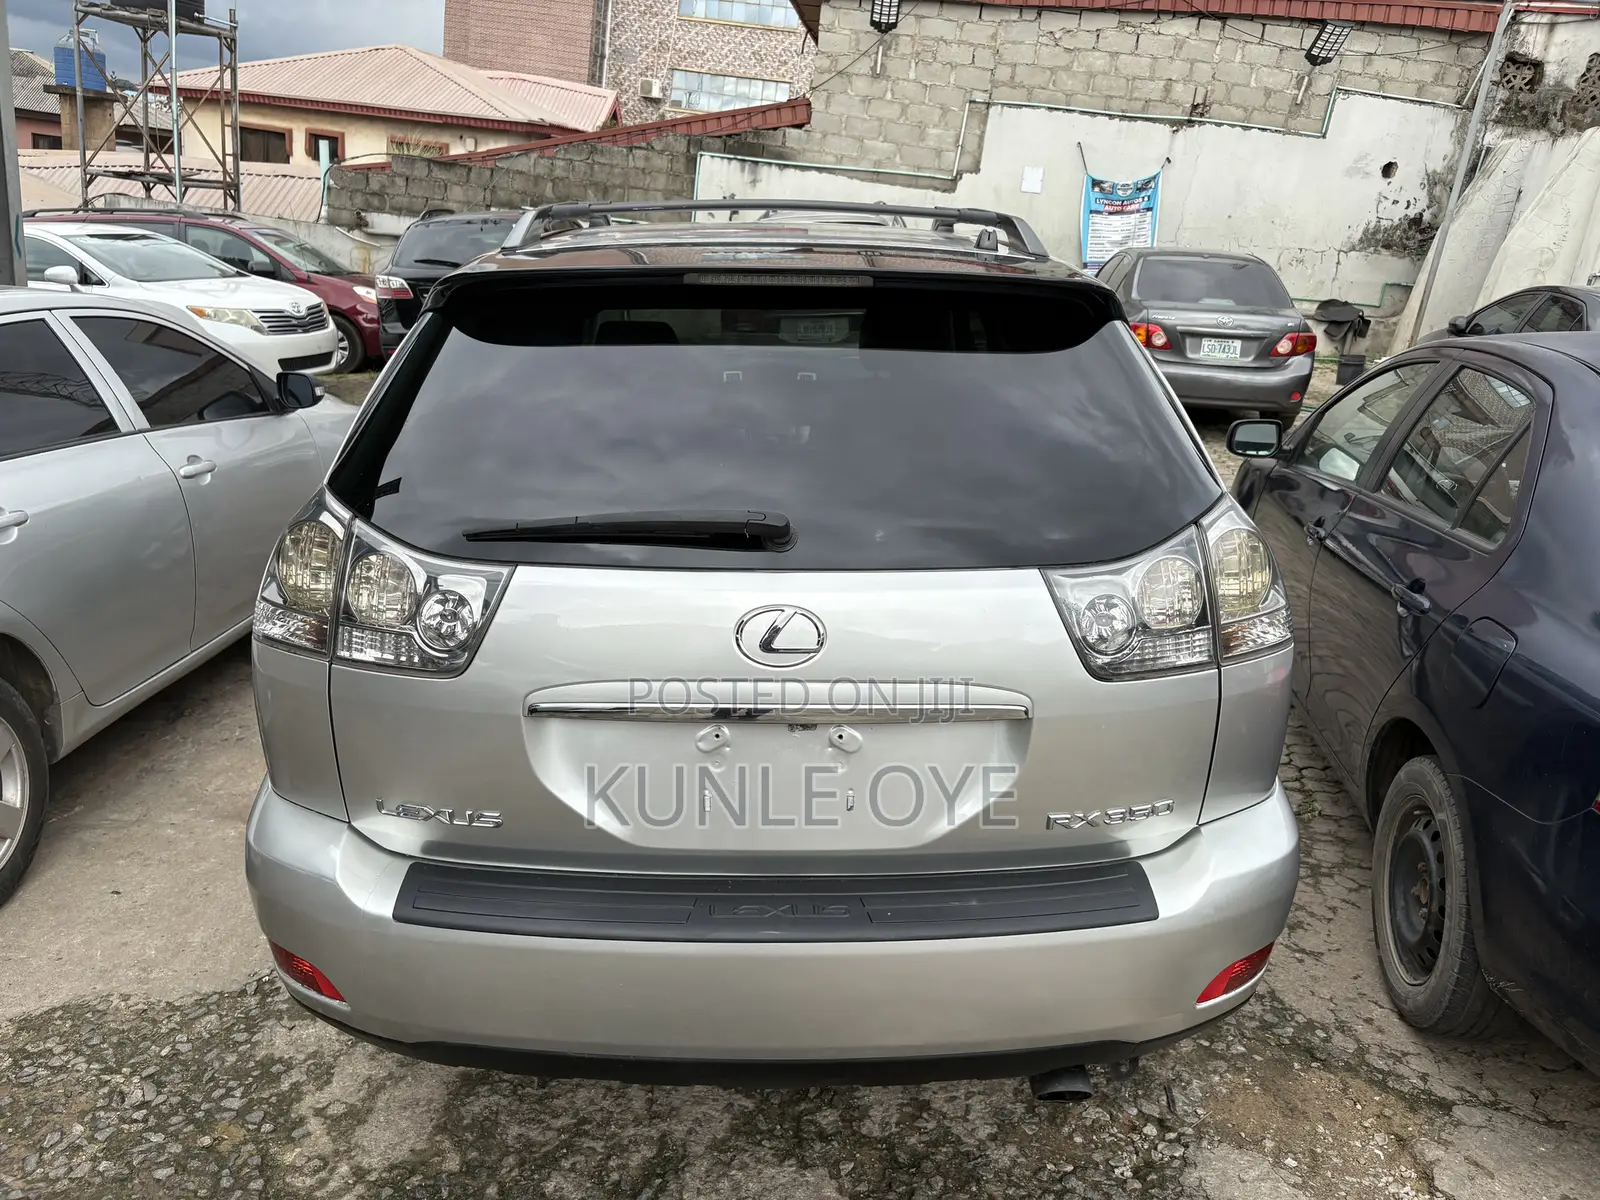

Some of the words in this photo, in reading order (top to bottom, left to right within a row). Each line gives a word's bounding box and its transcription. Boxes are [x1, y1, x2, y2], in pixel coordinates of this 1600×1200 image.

[1122, 197, 1143, 205] AUTOS
[1104, 204, 1122, 212] AUTO
[1122, 203, 1140, 211] CARE
[375, 798, 503, 828] LEXUS
[708, 904, 851, 918] LEXUS
